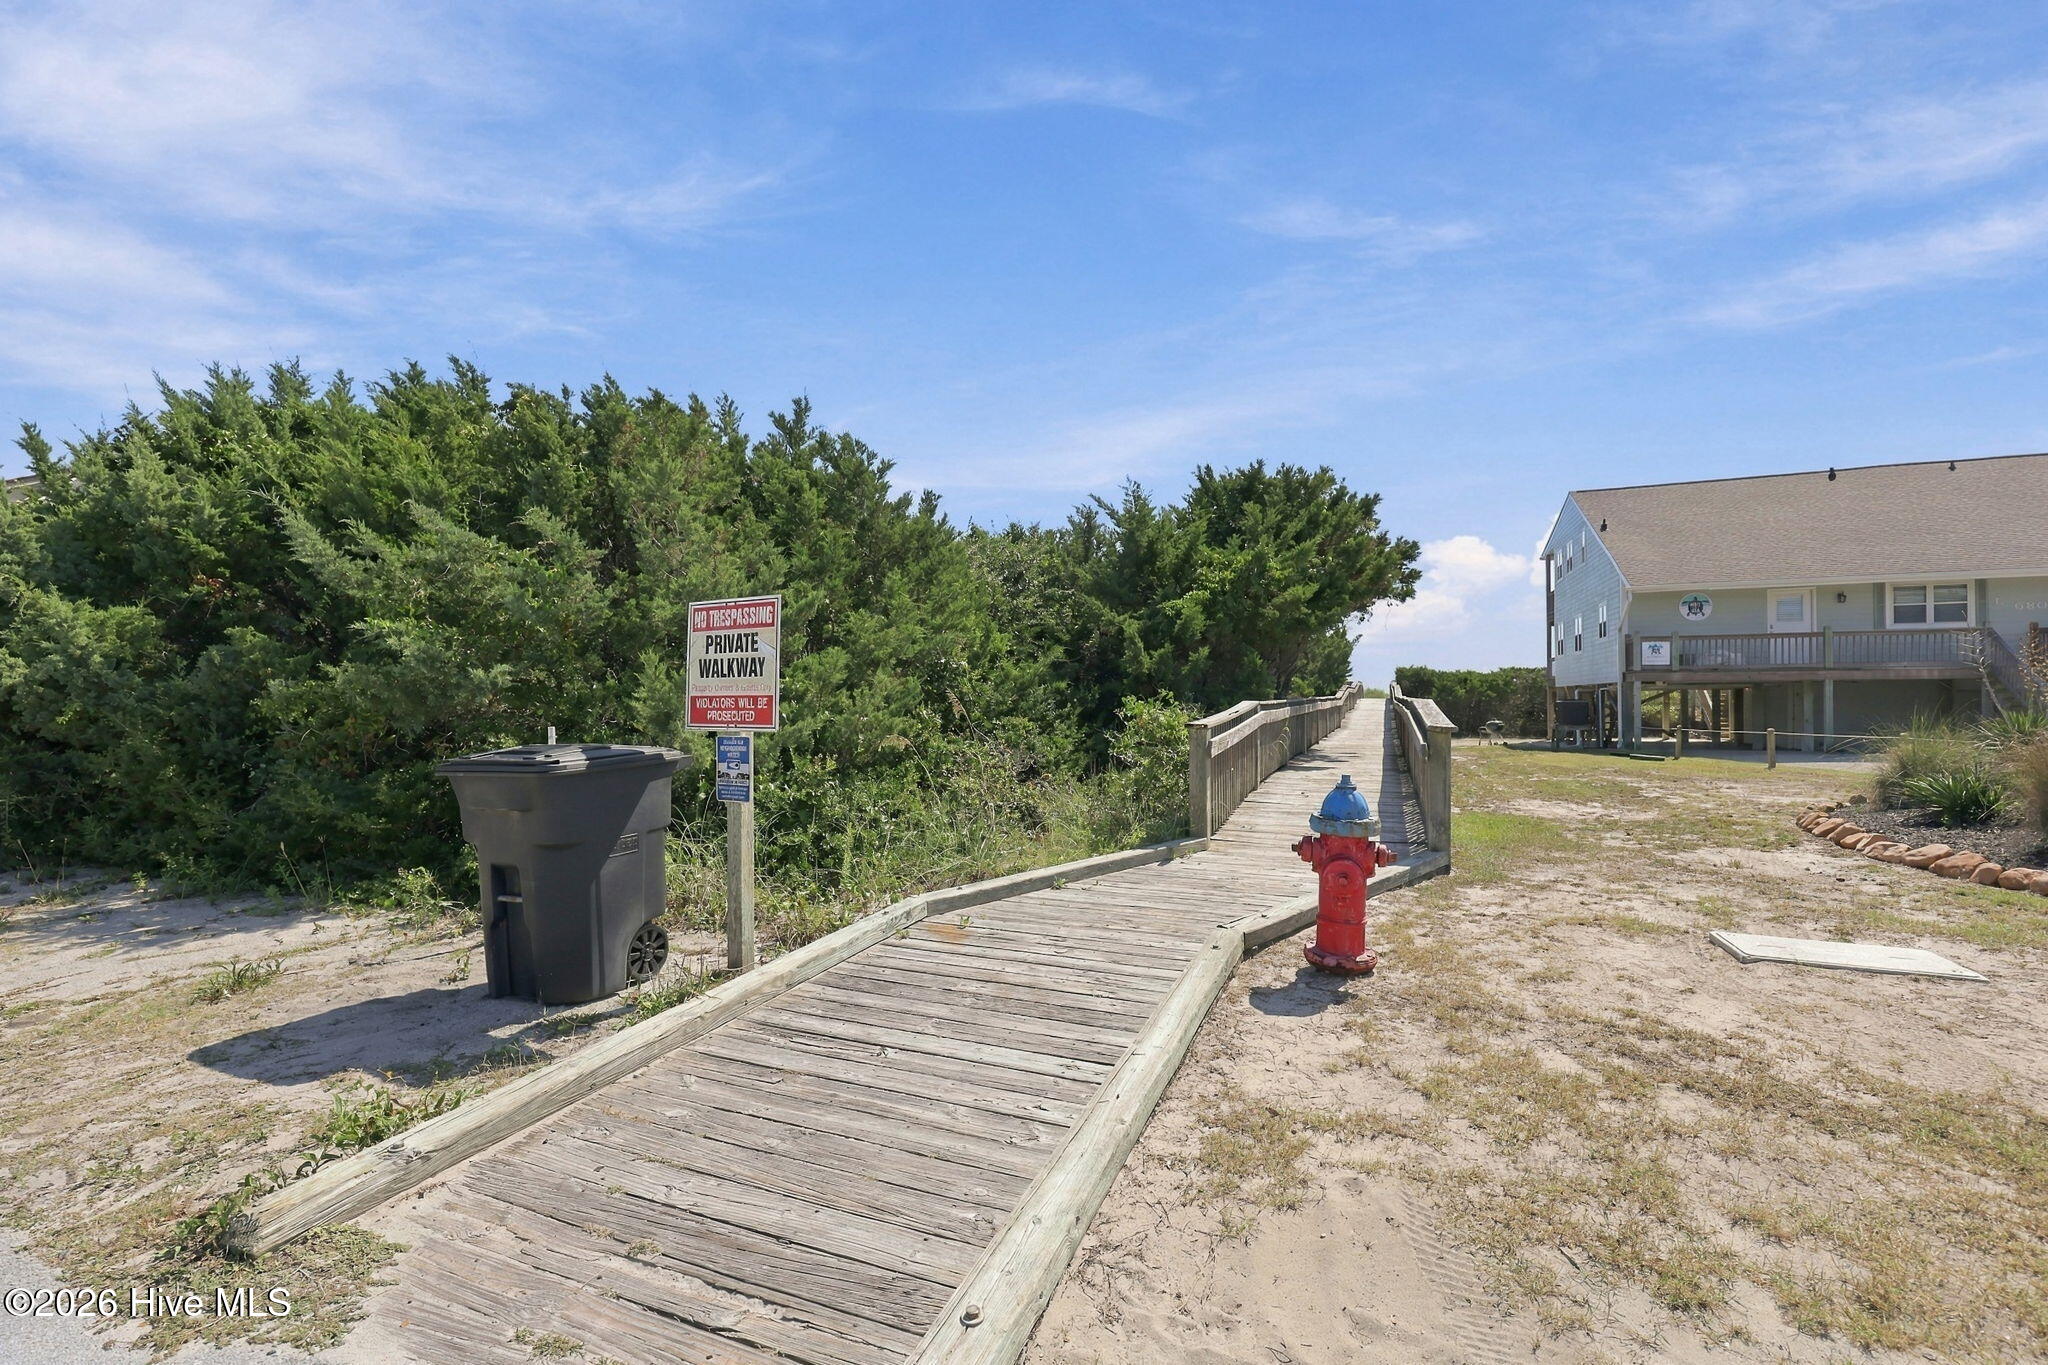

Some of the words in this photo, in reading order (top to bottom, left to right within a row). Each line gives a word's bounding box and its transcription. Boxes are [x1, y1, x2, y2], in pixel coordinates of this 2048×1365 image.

[694, 611, 707, 628] NO
[709, 606, 774, 627] TRESPASSING
[705, 632, 759, 654] PRIVATE
[698, 657, 766, 679] WALKWAY
[695, 697, 735, 709] VIOLATORS
[737, 697, 755, 709] WILL
[757, 697, 768, 708] BE
[707, 710, 755, 722] PROSECUTED
